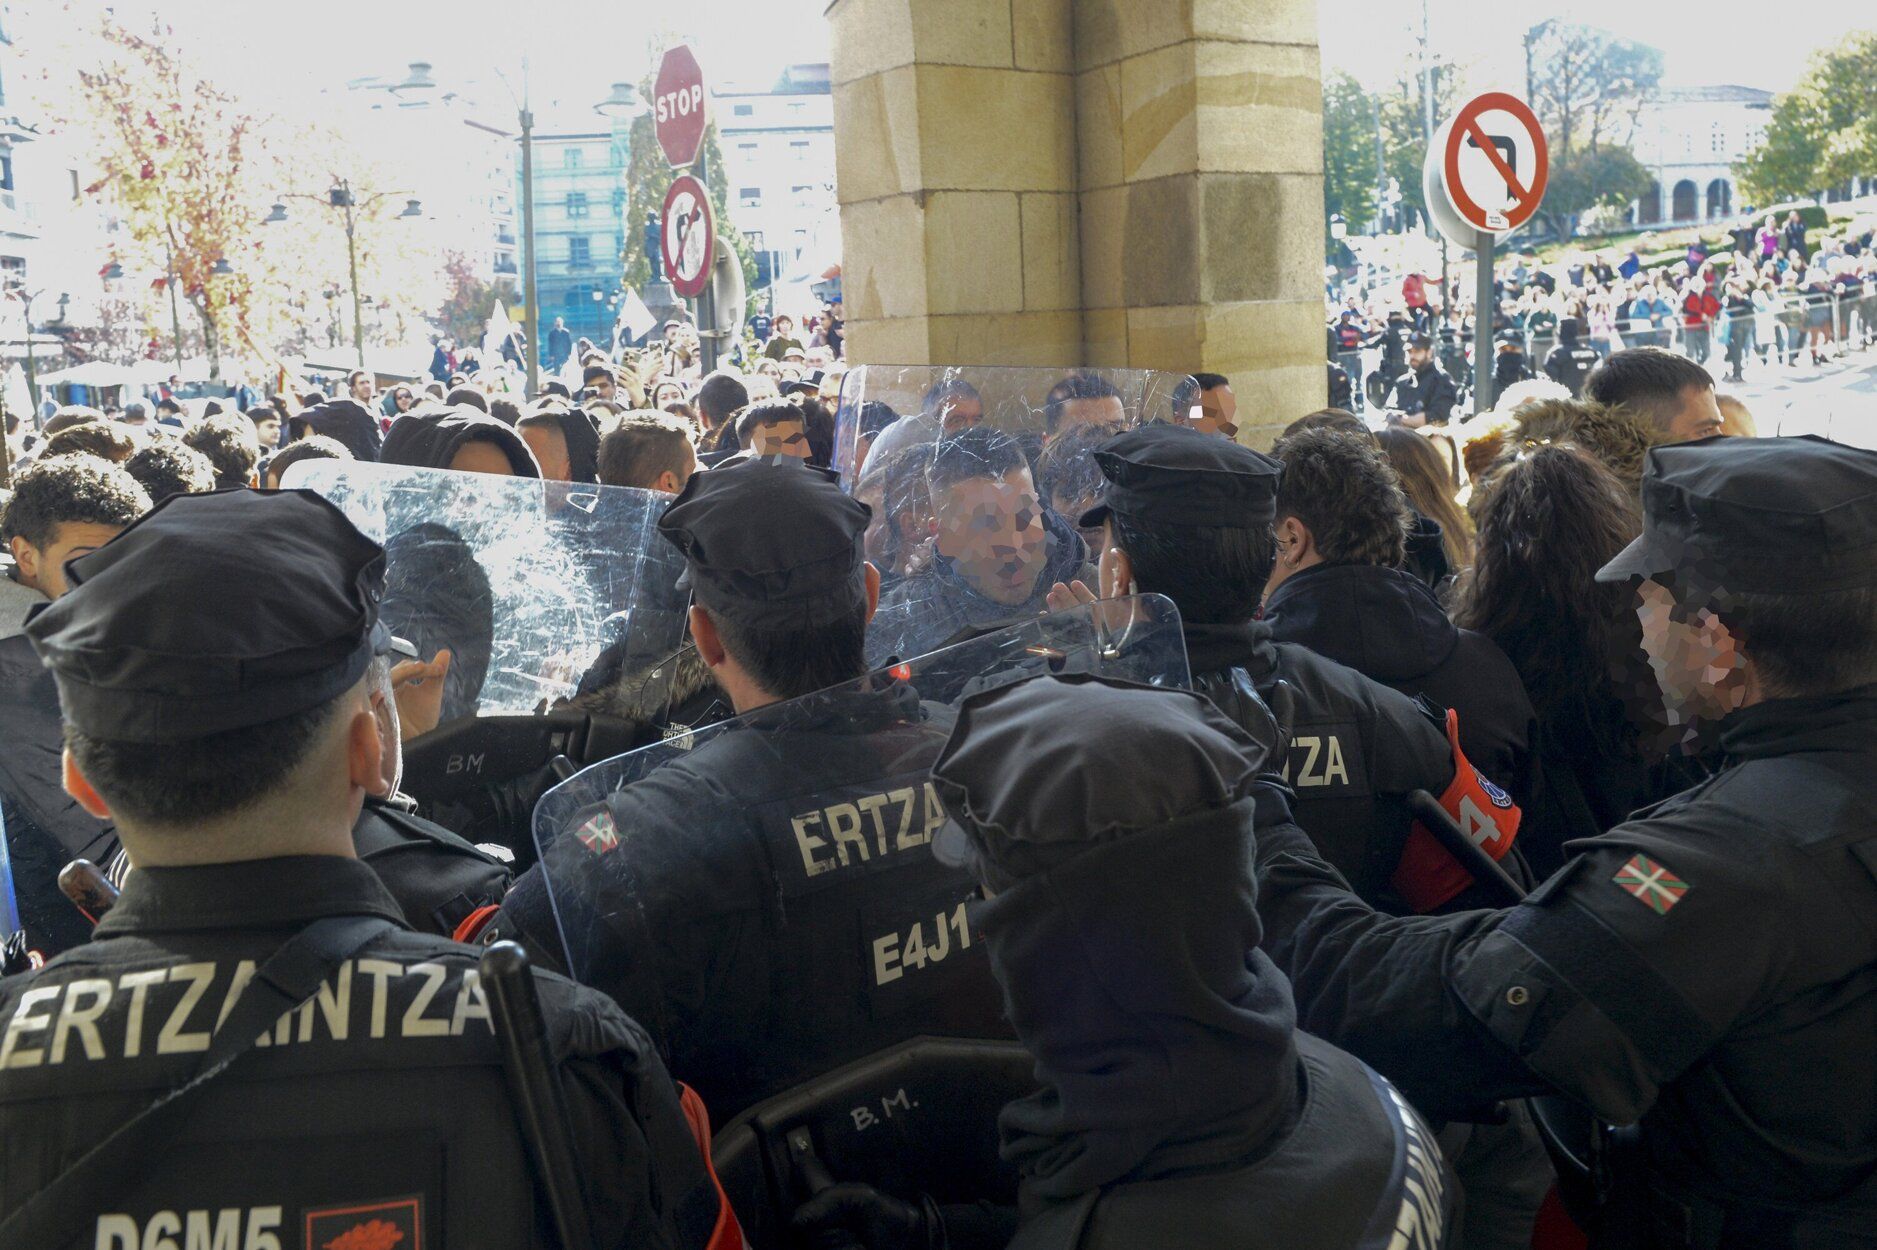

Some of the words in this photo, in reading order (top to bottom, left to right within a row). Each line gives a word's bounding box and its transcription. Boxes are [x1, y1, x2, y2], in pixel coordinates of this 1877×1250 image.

[657, 84, 702, 123] STOP
[670, 722, 685, 731] THE
[446, 753, 485, 774] BM
[791, 782, 947, 877] ERTZA
[1459, 794, 1501, 848] 4
[873, 902, 971, 986] E4J1
